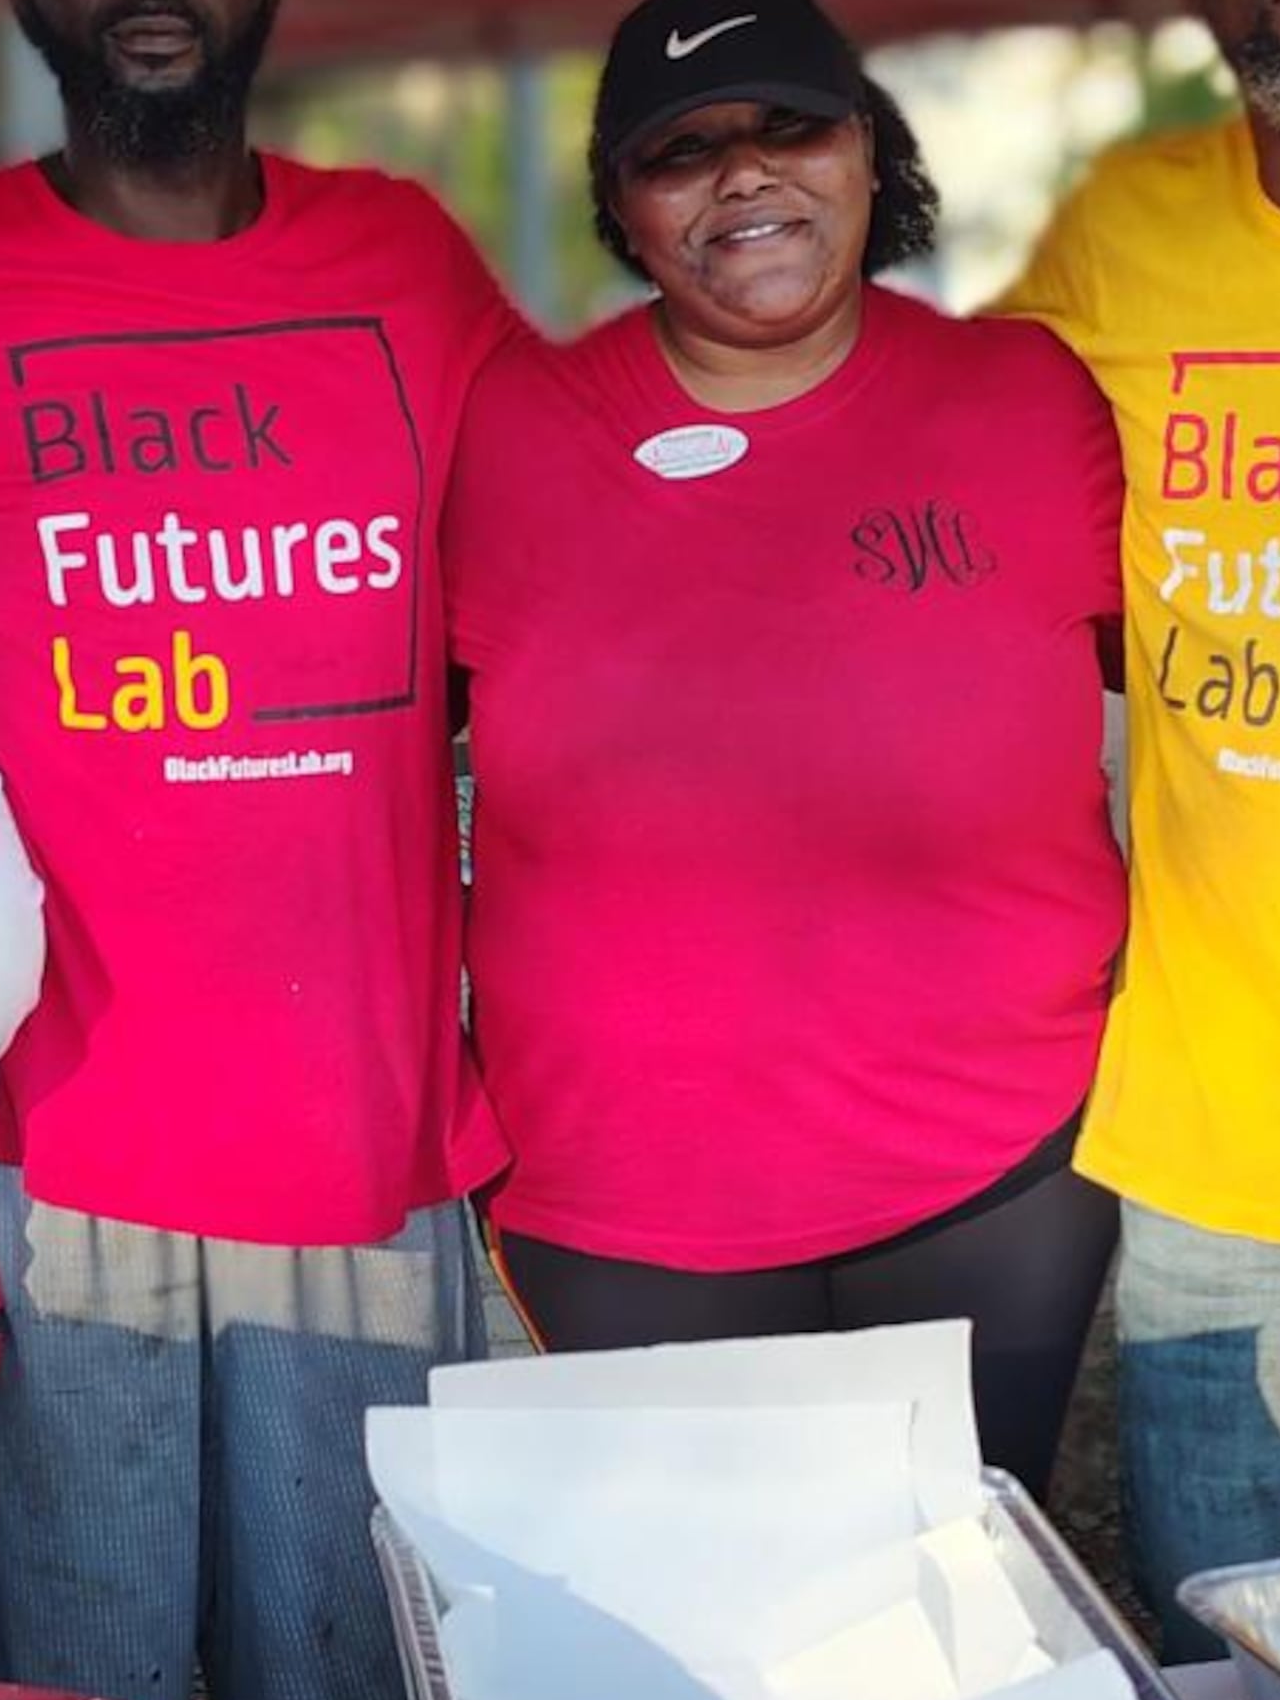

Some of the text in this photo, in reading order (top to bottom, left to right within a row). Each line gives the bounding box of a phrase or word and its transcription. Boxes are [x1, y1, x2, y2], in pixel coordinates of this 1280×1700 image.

[22, 383, 293, 485] Black
[36, 511, 403, 607] Futures
[52, 630, 230, 732] Lab
[1159, 625, 1280, 727] Lab
